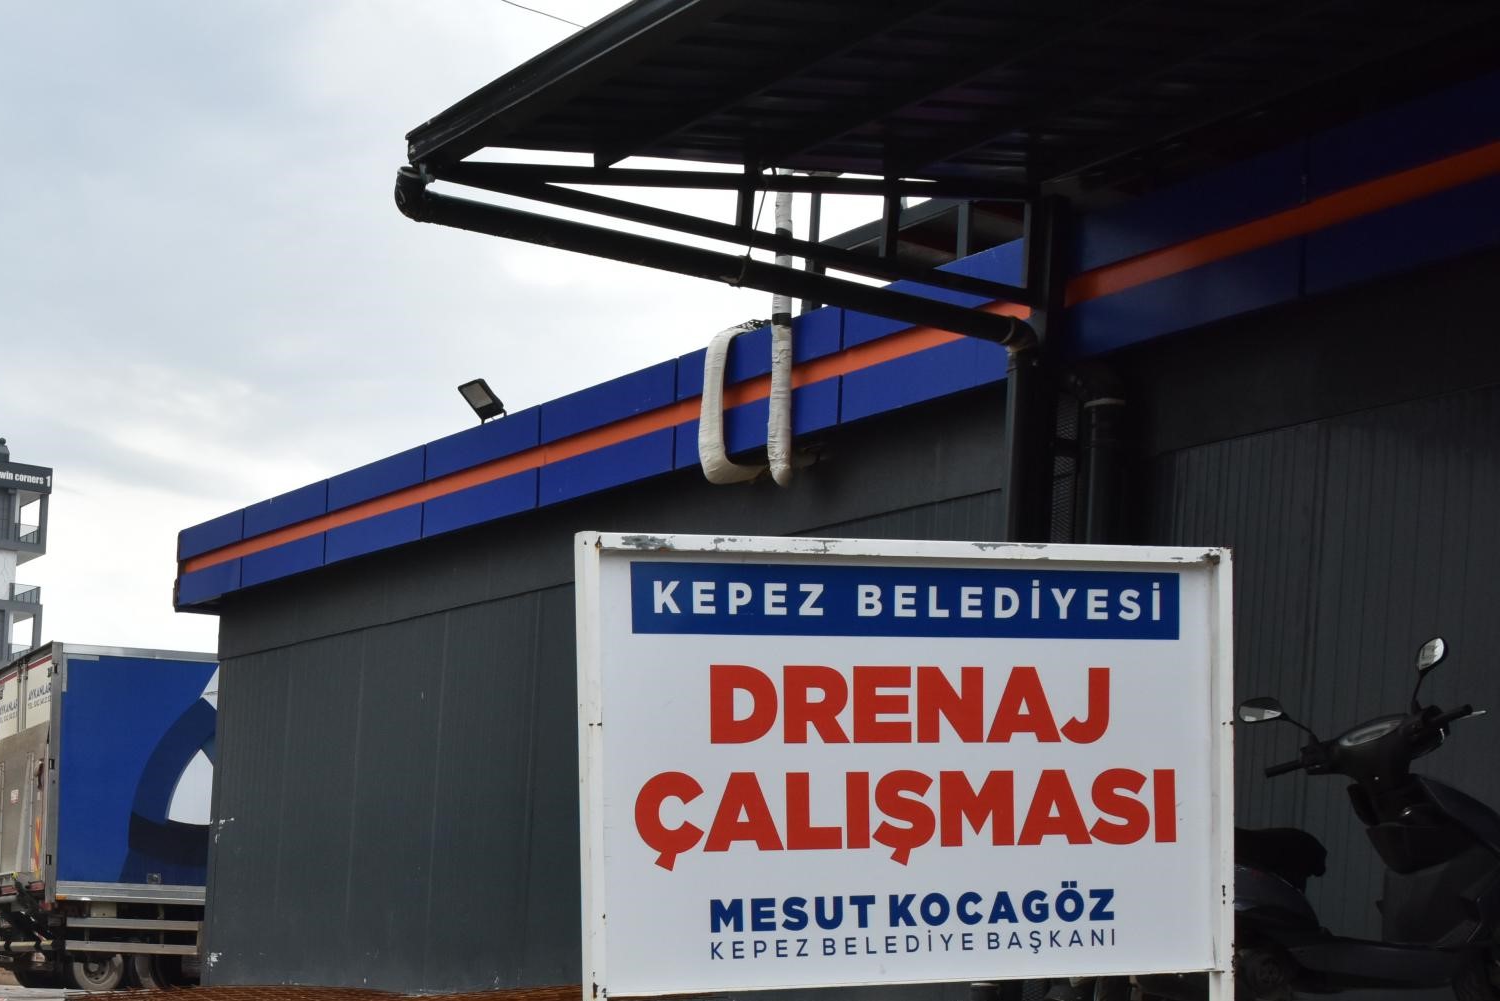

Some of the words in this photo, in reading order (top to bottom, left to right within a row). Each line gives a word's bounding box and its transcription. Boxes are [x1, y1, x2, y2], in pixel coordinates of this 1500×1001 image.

[14, 473, 44, 485] corners
[46, 475, 51, 488] 1
[653, 580, 824, 616] KEPEZ
[857, 580, 1162, 621] BELEDİYESİ
[709, 664, 1111, 745] DRENAJ
[633, 768, 1178, 871] ÇALIŞMASI
[709, 894, 876, 933] MESUT
[889, 881, 1116, 927] KOCAGÖZ
[710, 933, 811, 960] KEPEZ
[822, 929, 976, 957] BELEDİYE
[987, 927, 1117, 955] BAŞKANI
